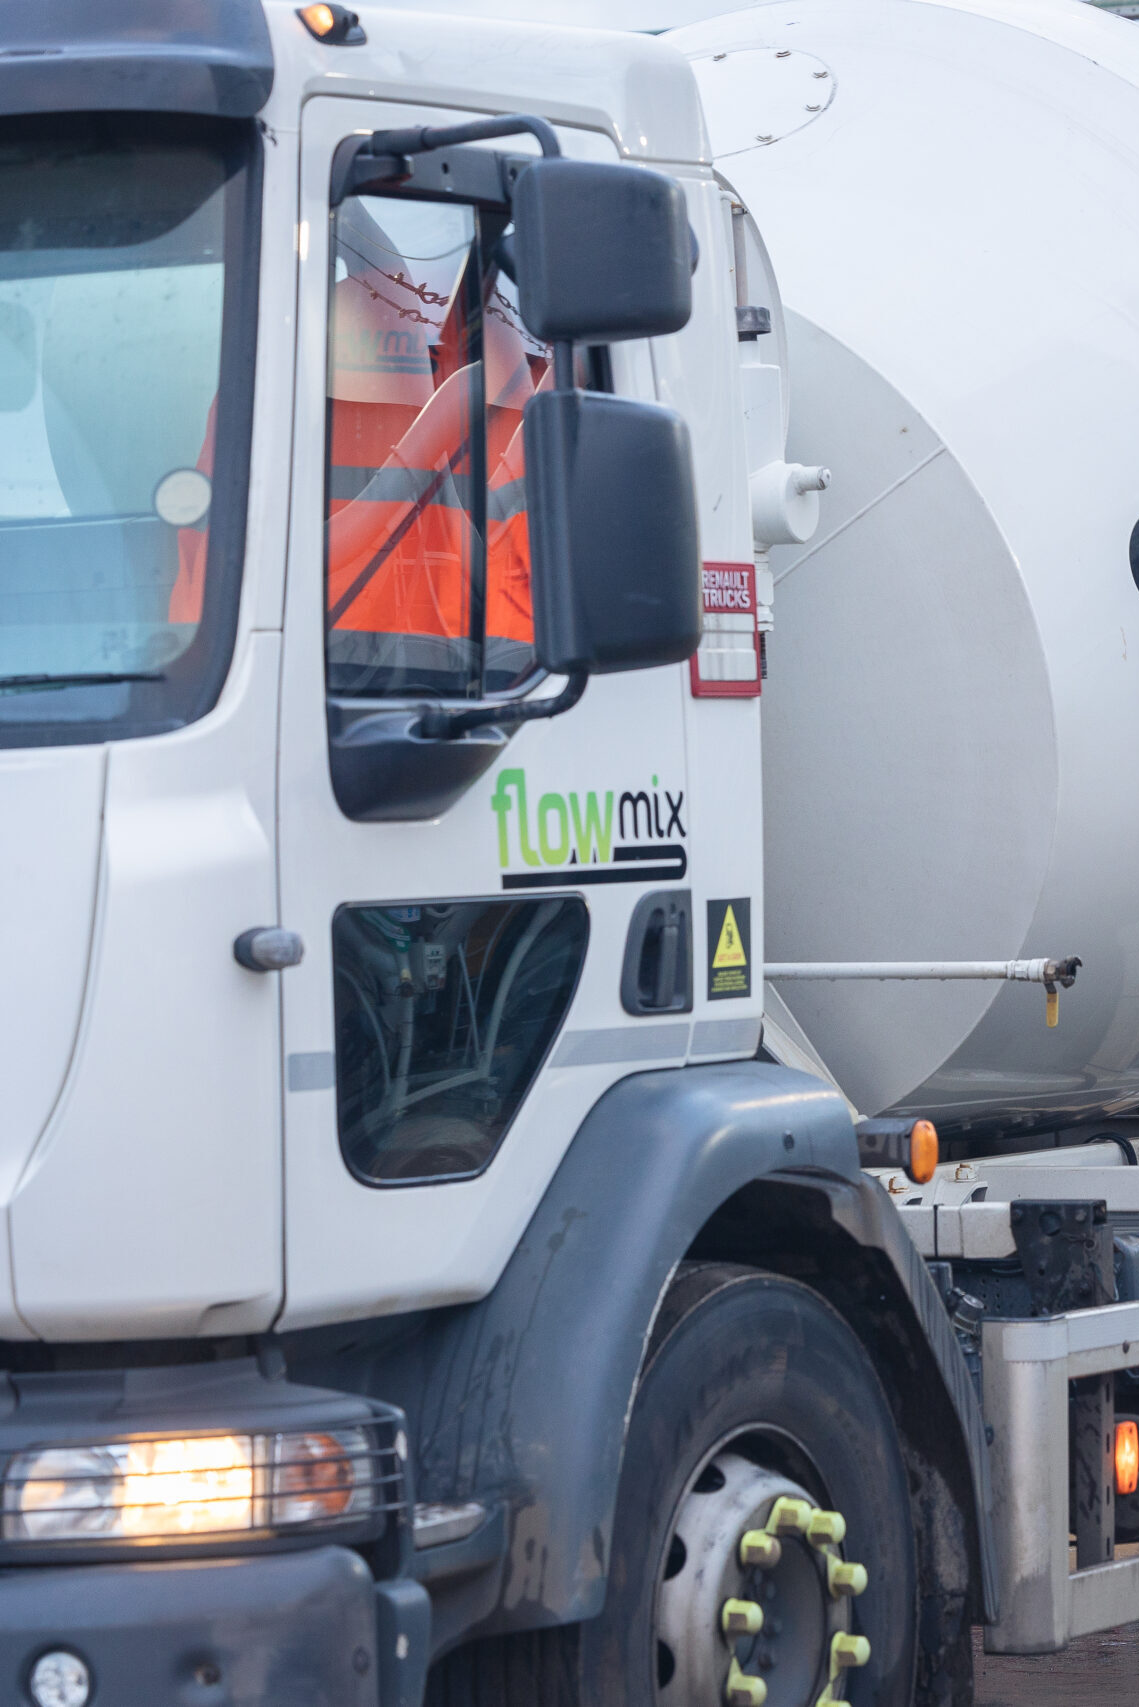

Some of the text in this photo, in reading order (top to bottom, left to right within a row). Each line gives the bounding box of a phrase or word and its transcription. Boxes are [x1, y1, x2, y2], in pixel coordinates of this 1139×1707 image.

[702, 570, 750, 590] RENAULT
[703, 589, 750, 609] TRUCKS
[491, 768, 687, 868] flowmix
